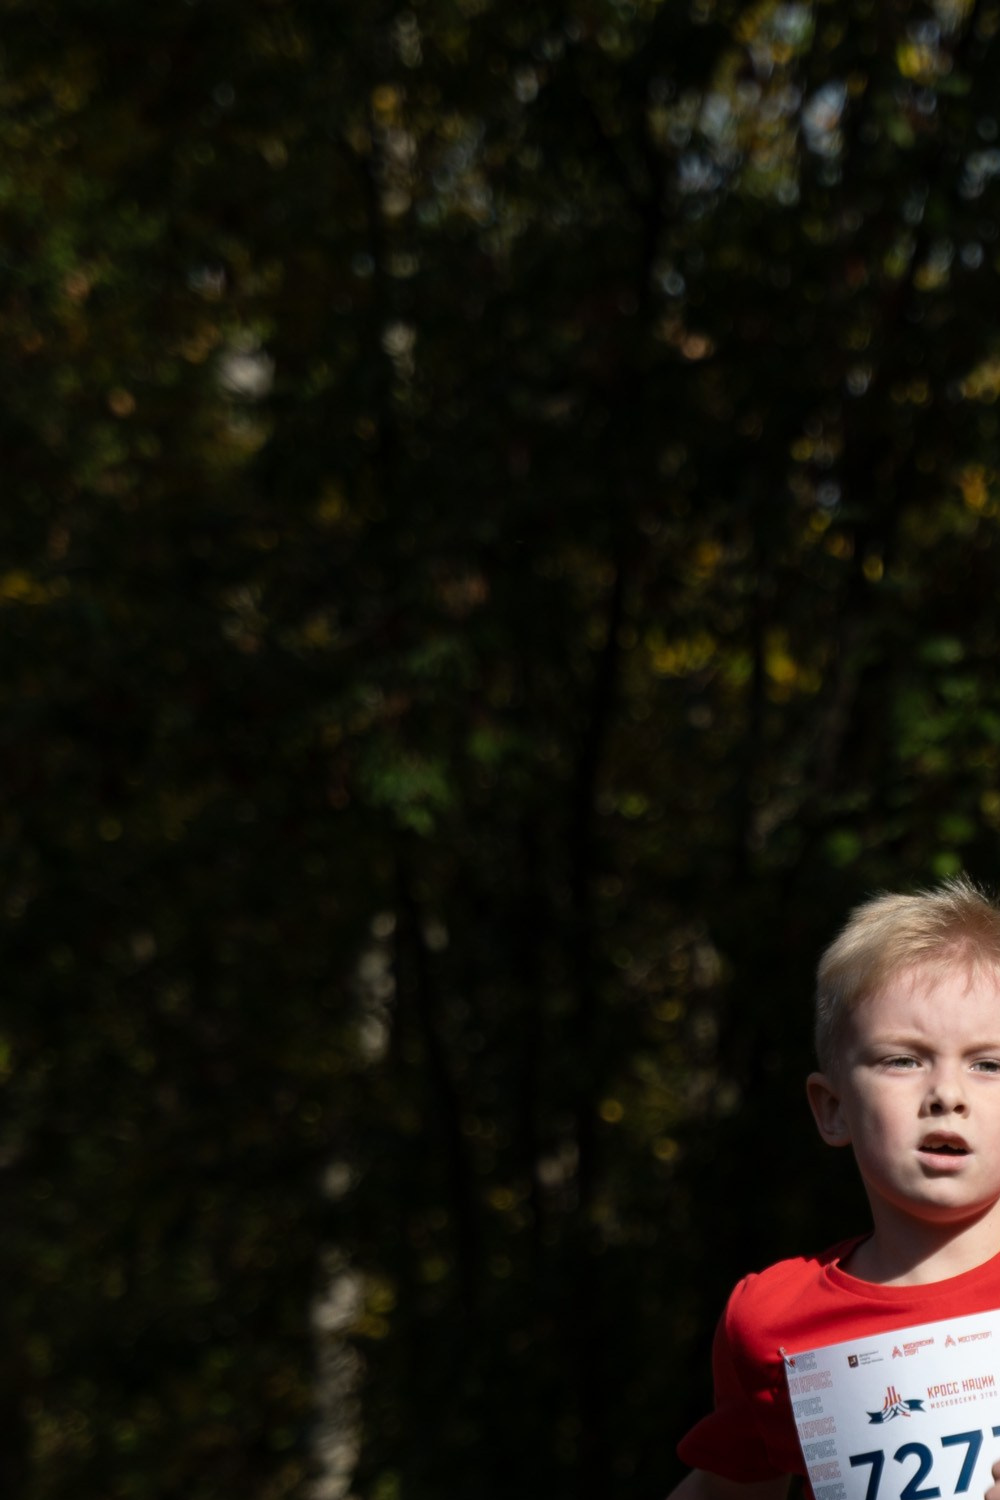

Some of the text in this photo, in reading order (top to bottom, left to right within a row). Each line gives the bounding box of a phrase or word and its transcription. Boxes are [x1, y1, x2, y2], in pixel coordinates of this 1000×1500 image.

[927, 1374, 996, 1399] КРОСС НАЦИИ
[930, 1395, 977, 1409] МОСКОВСКИЙ
